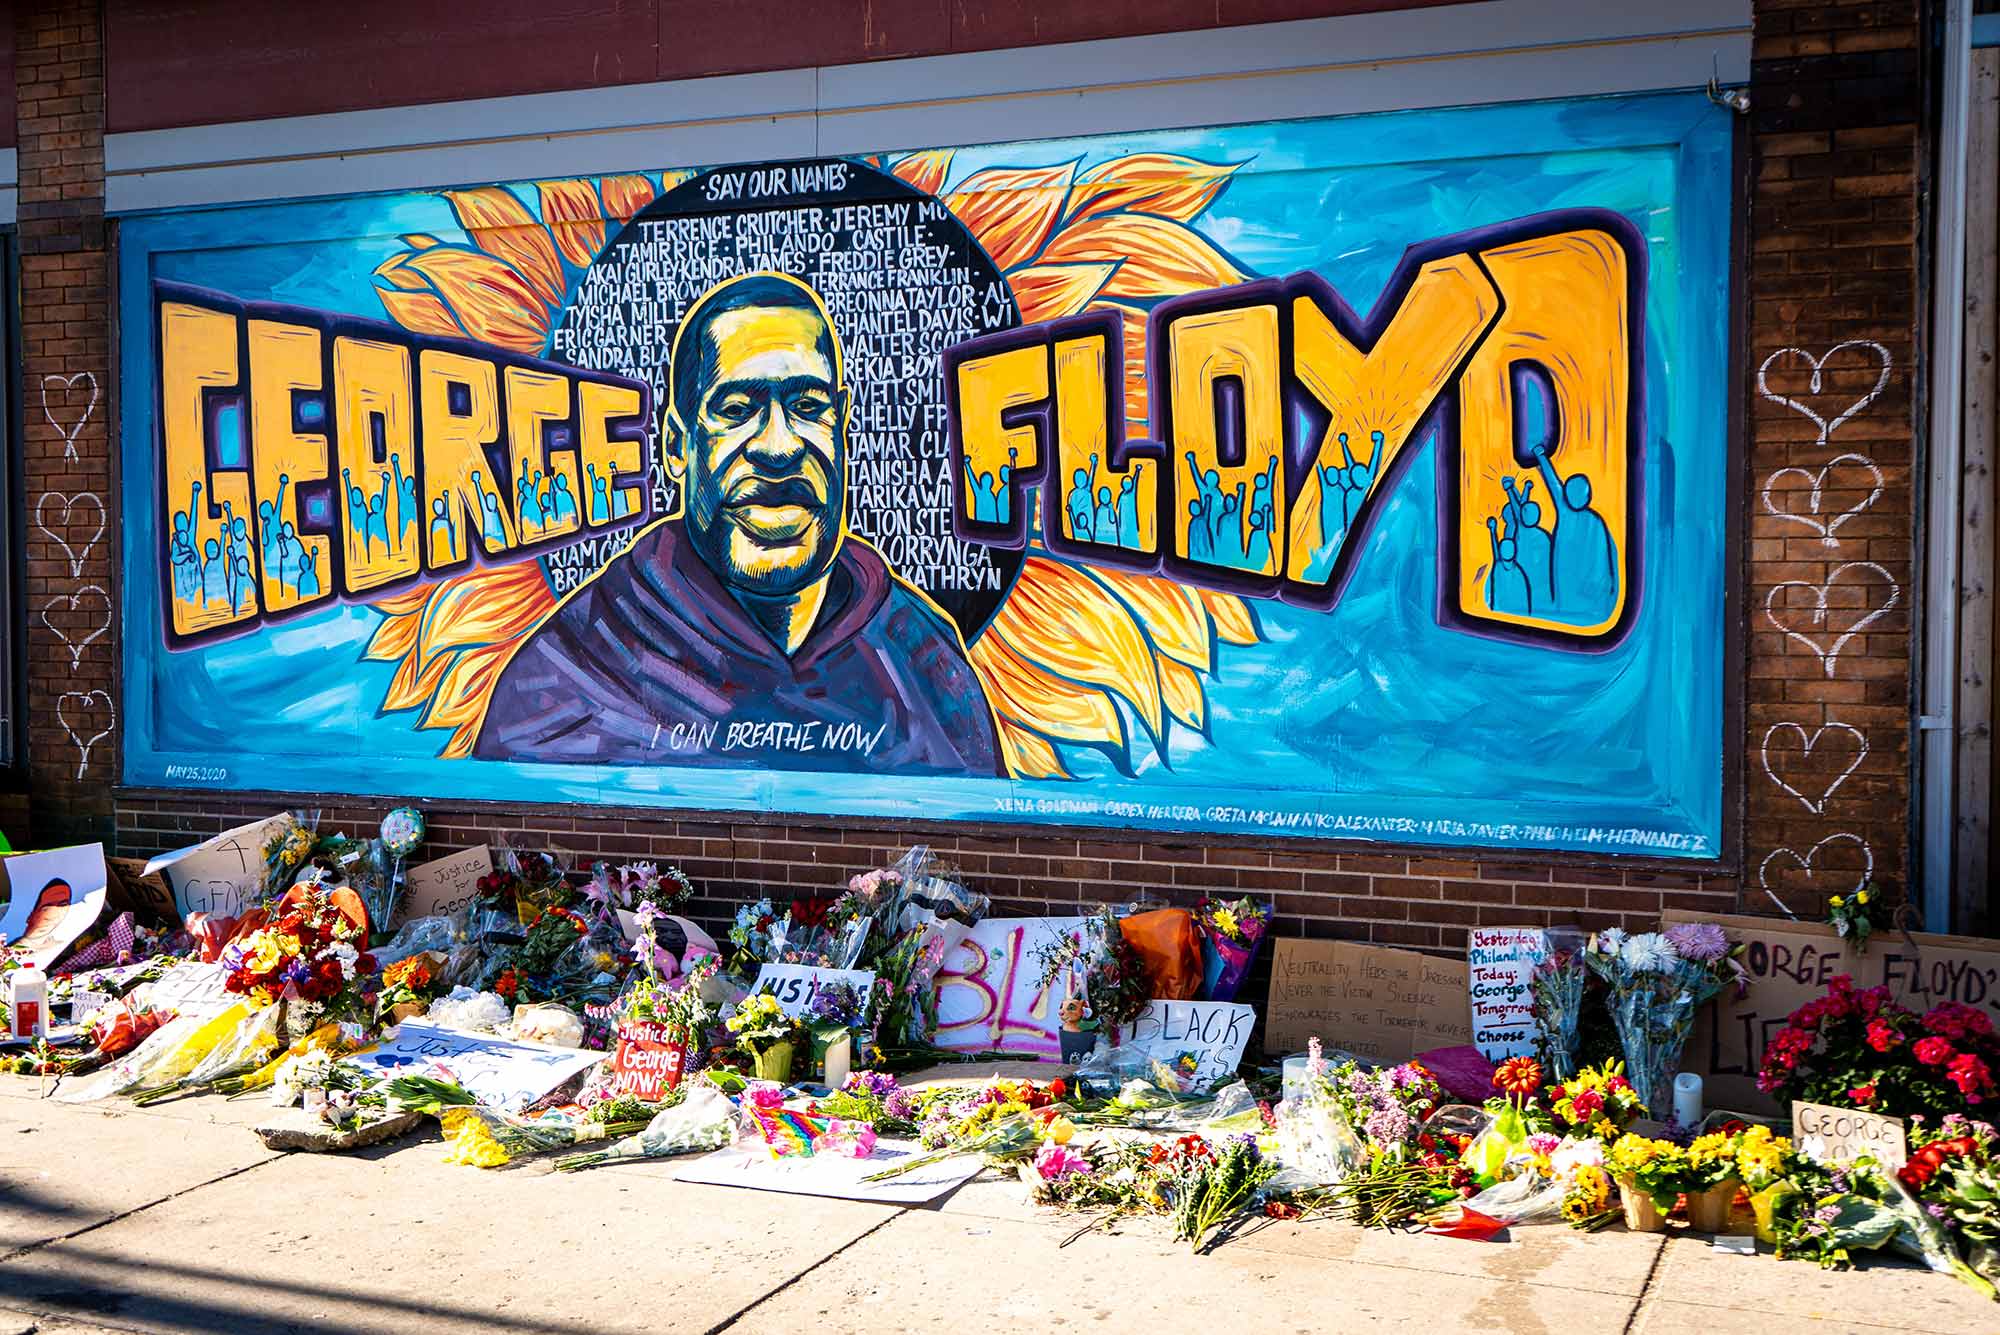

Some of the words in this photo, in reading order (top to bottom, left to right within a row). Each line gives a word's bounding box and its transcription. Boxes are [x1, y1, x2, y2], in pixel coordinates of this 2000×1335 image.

[706, 172, 746, 200] SAY
[751, 169, 790, 198] OUR
[791, 163, 848, 194] NAMES
[638, 216, 731, 242] TERRENCE
[736, 207, 824, 240] CRUTCHER
[831, 203, 910, 232] JEREMY
[616, 241, 669, 264] TAMIR
[672, 240, 720, 262] RICE
[736, 231, 835, 257] PHILANDO
[852, 225, 928, 251] CASTILE
[585, 263, 622, 286] AKAI
[625, 259, 679, 285] GURLEY
[680, 256, 746, 281] KENDRA
[747, 251, 806, 275] JAMES
[818, 249, 894, 273] FREDDIE
[899, 244, 951, 269] GREY
[577, 282, 650, 306] MICHAEL
[808, 271, 885, 294] TERRANCE
[887, 267, 970, 290] FRANKLIN
[824, 289, 907, 314] BREONNA
[906, 284, 977, 310] TAYLOR
[983, 280, 1010, 306] AL
[565, 304, 624, 329] TYISHA
[631, 301, 687, 326] MILLE
[836, 311, 917, 337] SHANTEL
[918, 305, 974, 331] DAVIS
[981, 303, 1012, 328] WI
[554, 327, 592, 351] ERIC
[593, 325, 669, 349] GARNER
[838, 332, 916, 359] WALTER
[565, 346, 635, 371] SANDRA
[640, 345, 670, 368] BLA
[843, 355, 897, 382] REKIA
[904, 377, 941, 406] SMI
[848, 404, 917, 432] SHELLY
[954, 224, 1632, 639] FLOYD
[847, 432, 915, 460] JAMAR
[158, 297, 645, 639] GEORGE
[847, 459, 933, 487] TANISHA
[652, 488, 676, 512] EY
[848, 484, 920, 510] TARIKA
[847, 509, 911, 537] ALTON
[914, 507, 951, 536] STE
[551, 567, 600, 592] BRIA
[901, 564, 1001, 591] KATHRYN
[650, 723, 661, 750] I
[670, 720, 719, 750] CAN
[722, 720, 822, 752] BREATHE
[822, 722, 888, 757] NOW
[1206, 805, 1246, 824] GRETA
[434, 860, 487, 885] Justice
[432, 889, 481, 918] Geor
[1473, 968, 1518, 986] Today:
[1731, 940, 1841, 987] ORGE
[1883, 953, 2000, 1010] FLOYD'
[756, 976, 869, 1012] JUSTE
[1272, 979, 1313, 1001] NEVER
[1131, 1003, 1250, 1045] BLACK
[1351, 1011, 1369, 1025] THE
[620, 1023, 668, 1043] Justice
[1476, 1030, 1526, 1044] Choose
[623, 1041, 681, 1078] George
[1799, 1107, 1897, 1144] GEORGE
